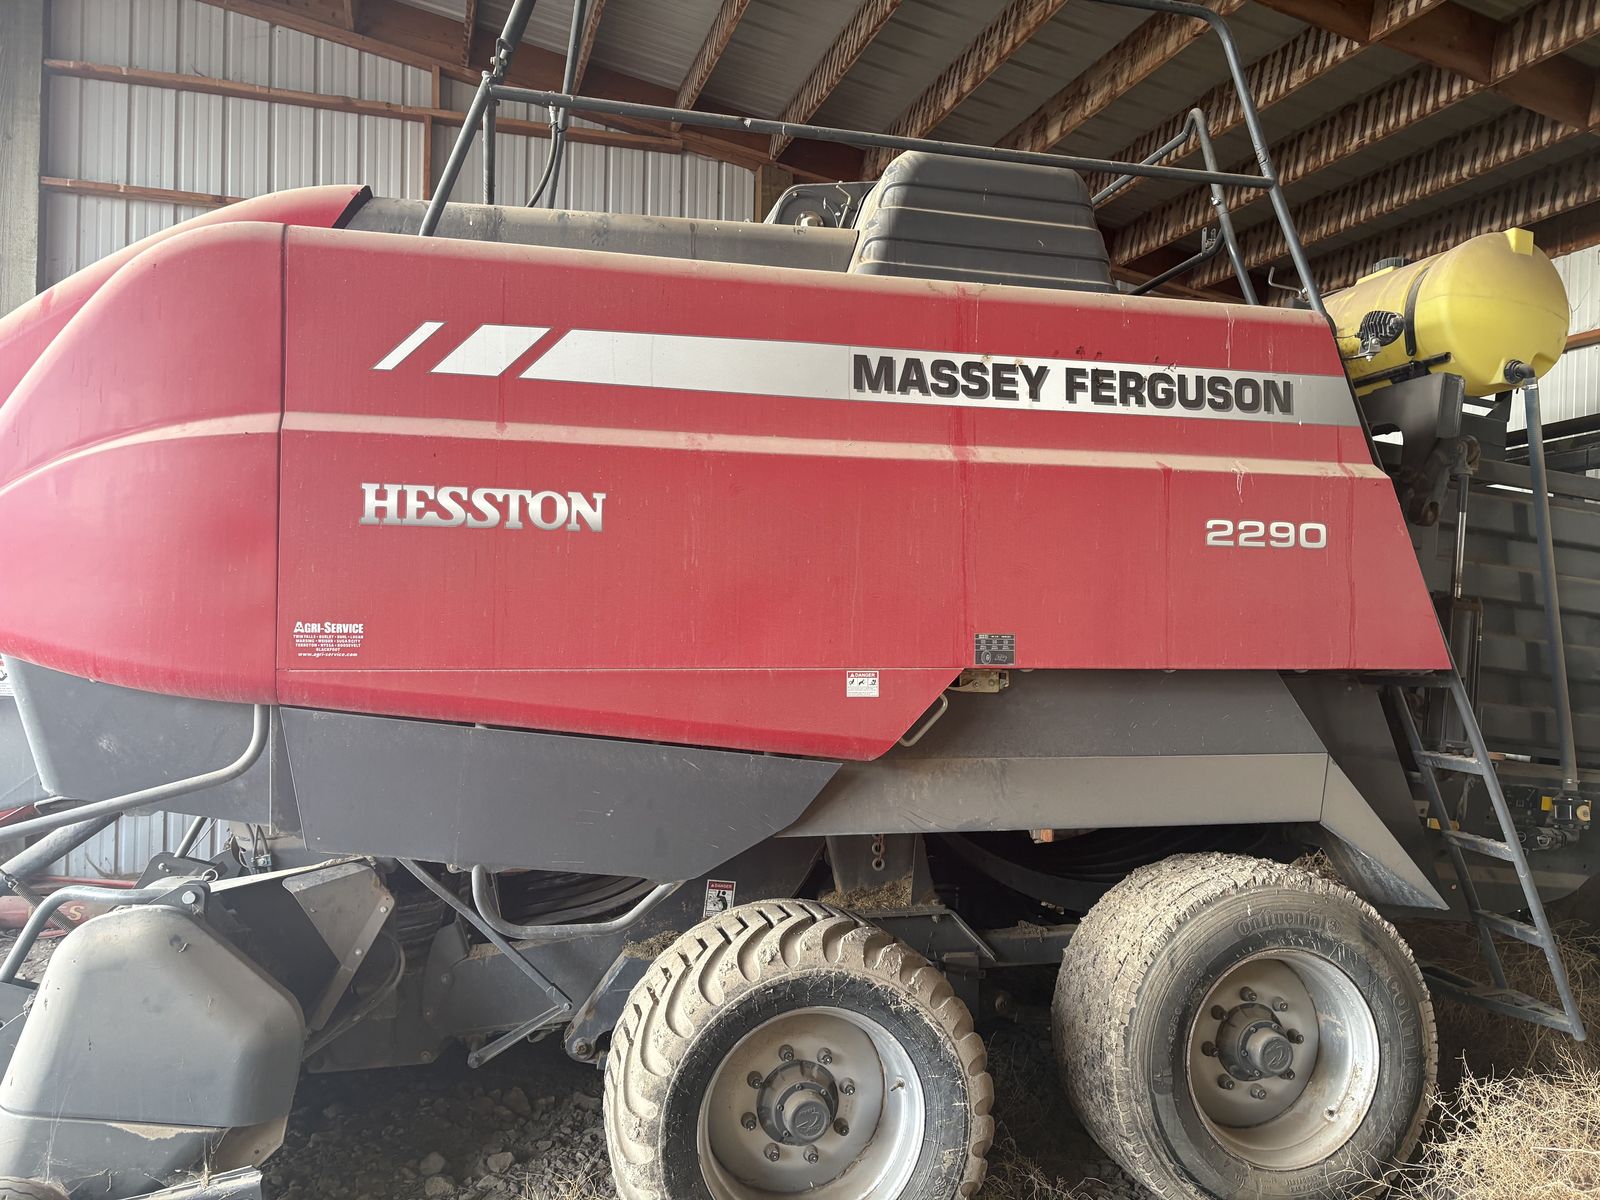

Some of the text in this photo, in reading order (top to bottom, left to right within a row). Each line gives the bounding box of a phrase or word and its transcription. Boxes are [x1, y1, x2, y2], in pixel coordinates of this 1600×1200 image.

[853, 354, 1293, 416] MASSEY FERGUSON
[359, 483, 606, 532] HESSTON
[1206, 519, 1327, 548] 2290
